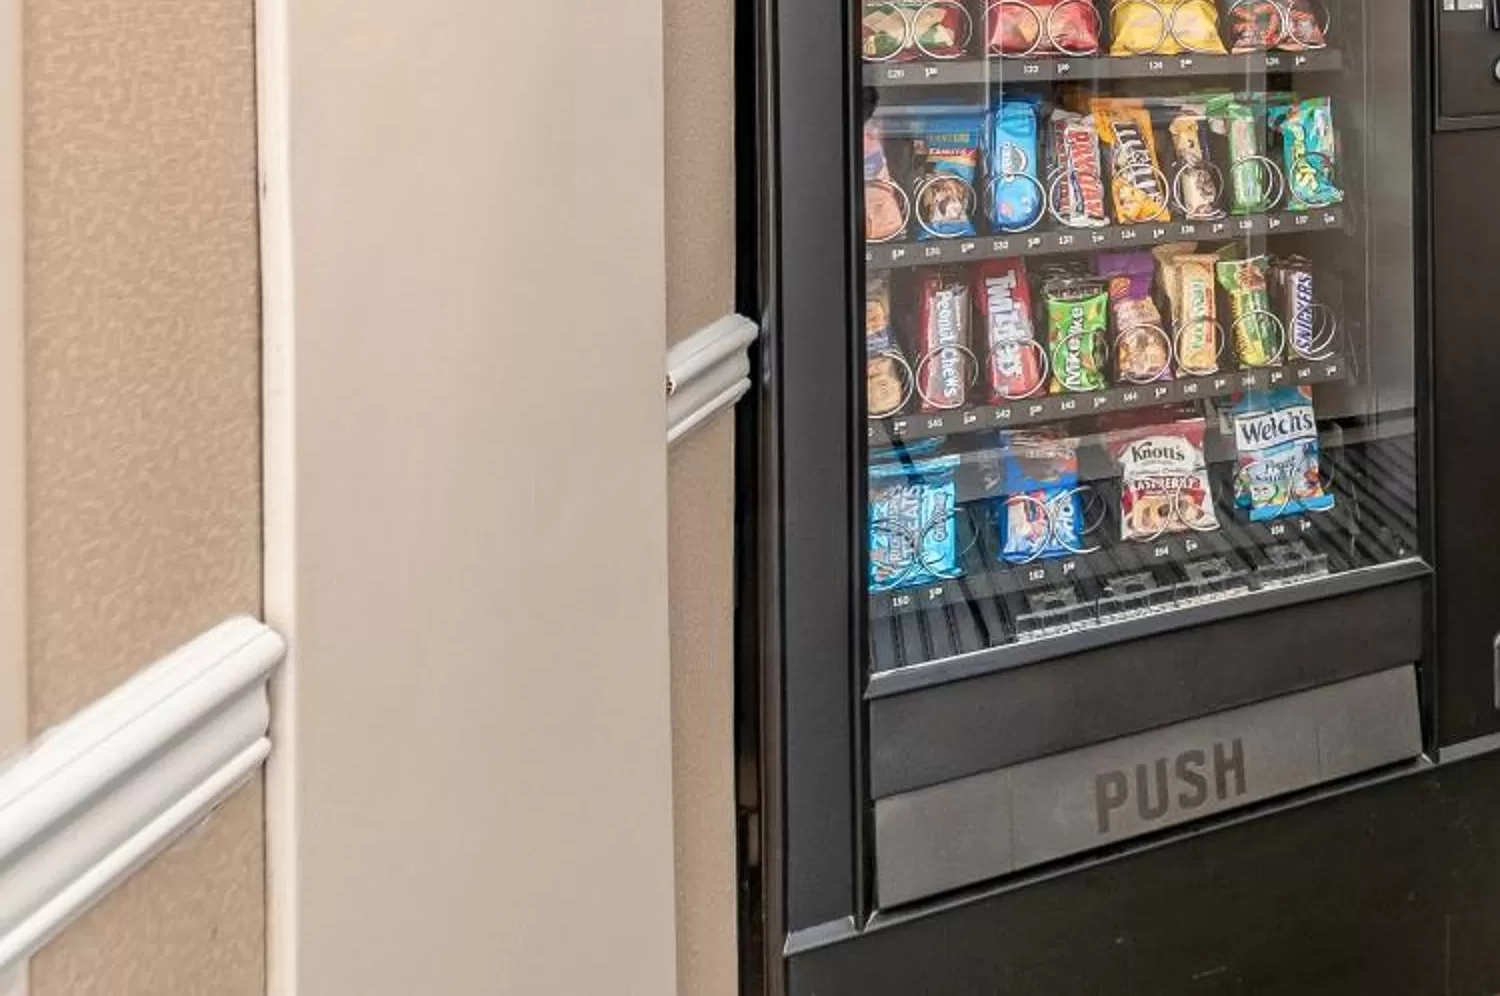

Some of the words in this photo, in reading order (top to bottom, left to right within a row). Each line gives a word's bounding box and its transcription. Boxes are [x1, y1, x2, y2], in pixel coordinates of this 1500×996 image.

[1295, 274, 1312, 352] SNICKERS
[1131, 441, 1185, 462] Knott's
[1242, 409, 1313, 445] Welch's
[1095, 736, 1247, 835] PUSH
